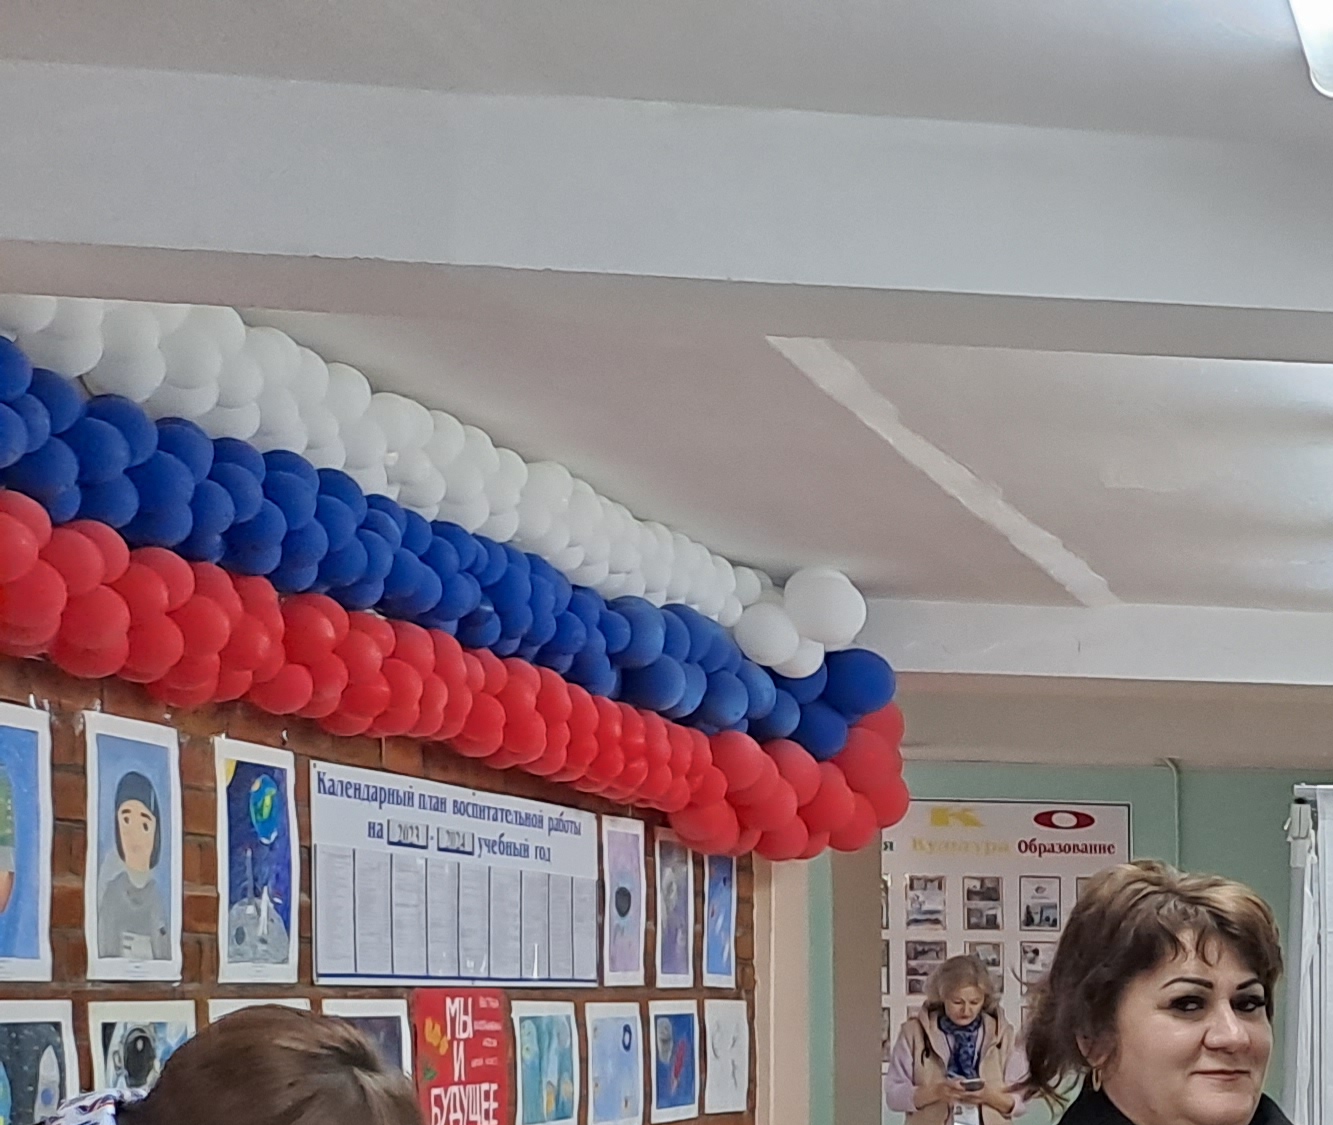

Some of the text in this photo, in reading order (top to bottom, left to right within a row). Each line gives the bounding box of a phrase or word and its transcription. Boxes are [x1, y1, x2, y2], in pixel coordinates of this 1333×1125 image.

[316, 771, 582, 836] Календарный план воспитательной работы
[367, 821, 385, 839] на
[477, 833, 530, 858] учебный
[535, 844, 552, 862] год
[1017, 838, 1116, 857] Образование
[446, 997, 473, 1040] МЫ
[453, 1041, 465, 1082] И
